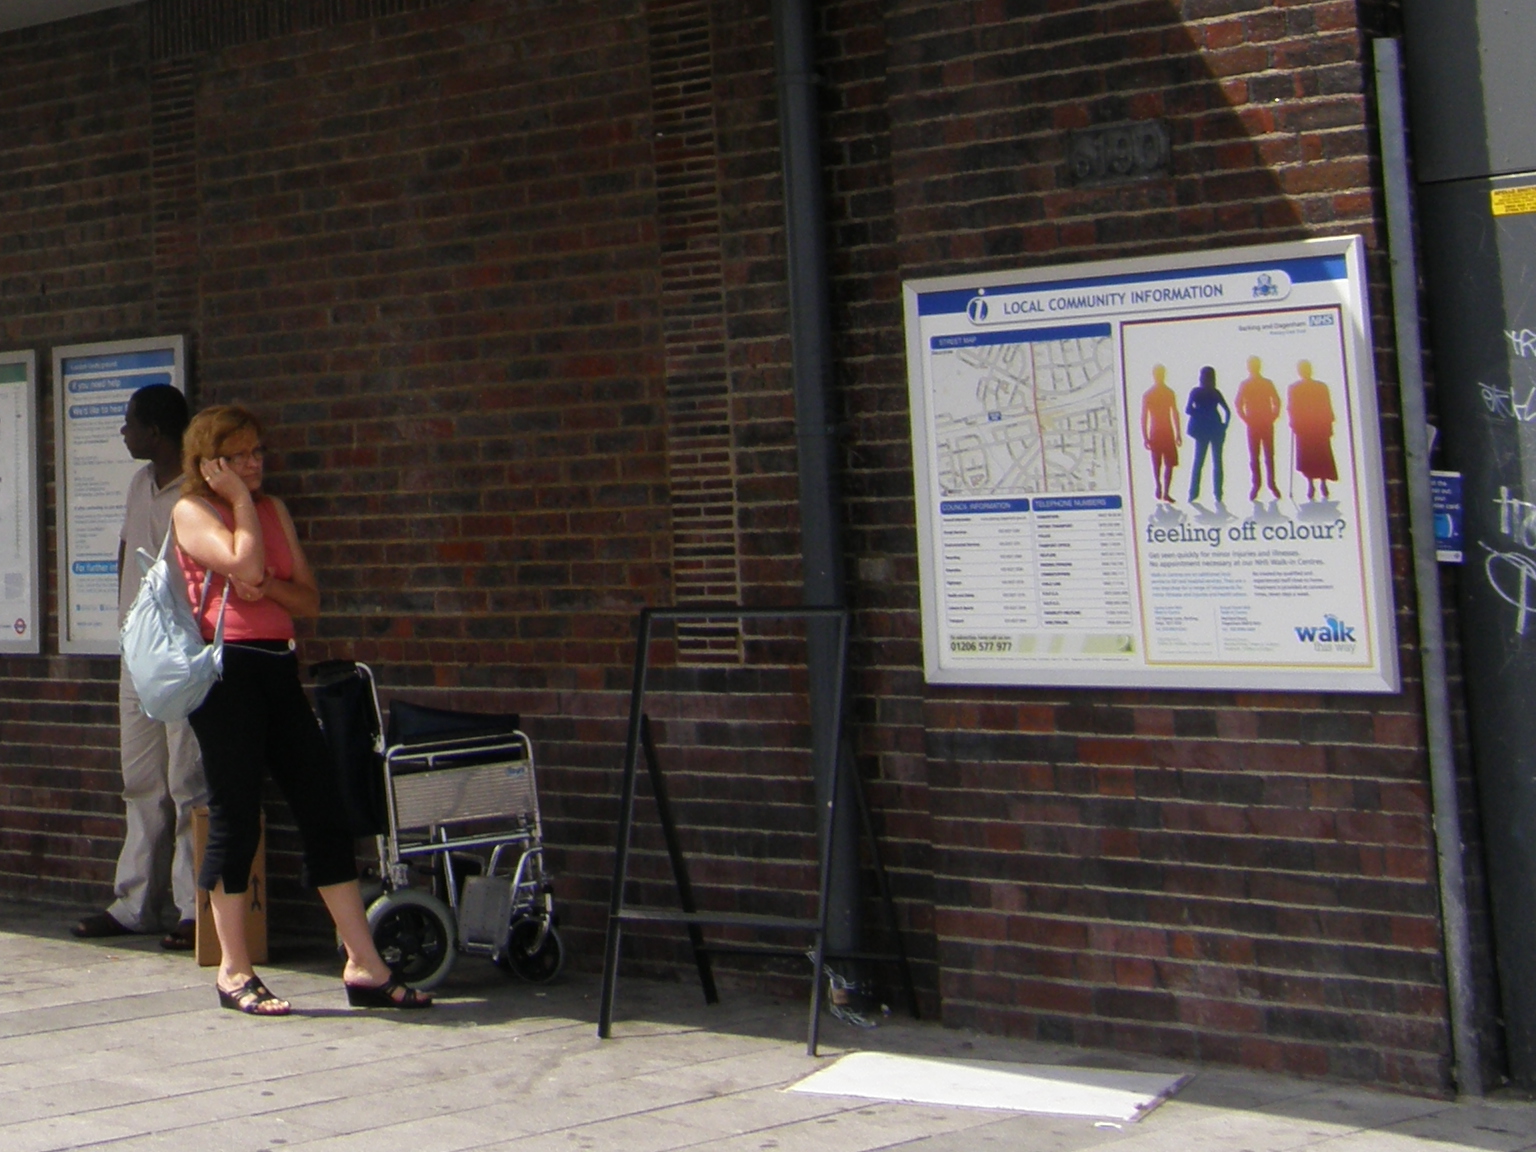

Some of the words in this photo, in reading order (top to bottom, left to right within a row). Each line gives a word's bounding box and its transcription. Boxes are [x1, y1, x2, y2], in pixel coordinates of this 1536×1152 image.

[1004, 297, 1044, 315] LOCAL
[1048, 292, 1126, 311] COMMUNITY
[1131, 284, 1223, 304] INFORMATION
[1310, 314, 1333, 326] NHS
[938, 337, 962, 346] STREET
[963, 335, 977, 344] MAP
[78, 382, 89, 391] you
[90, 379, 107, 388] need
[107, 379, 121, 389] help
[89, 405, 100, 414] like
[110, 404, 123, 413] hear
[969, 501, 1011, 510] INFORMATION
[1035, 499, 1073, 508] TELEPHONE
[1147, 523, 1222, 547] feeling
[1228, 521, 1258, 541] off
[1262, 519, 1346, 540] colour?
[1176, 551, 1199, 559] quickly
[75, 563, 85, 572] For
[86, 562, 108, 572] further
[1294, 617, 1356, 642] walk
[950, 641, 977, 651] 01206
[978, 641, 994, 651] 577
[996, 641, 1012, 651] 977
[1334, 643, 1356, 655] way
